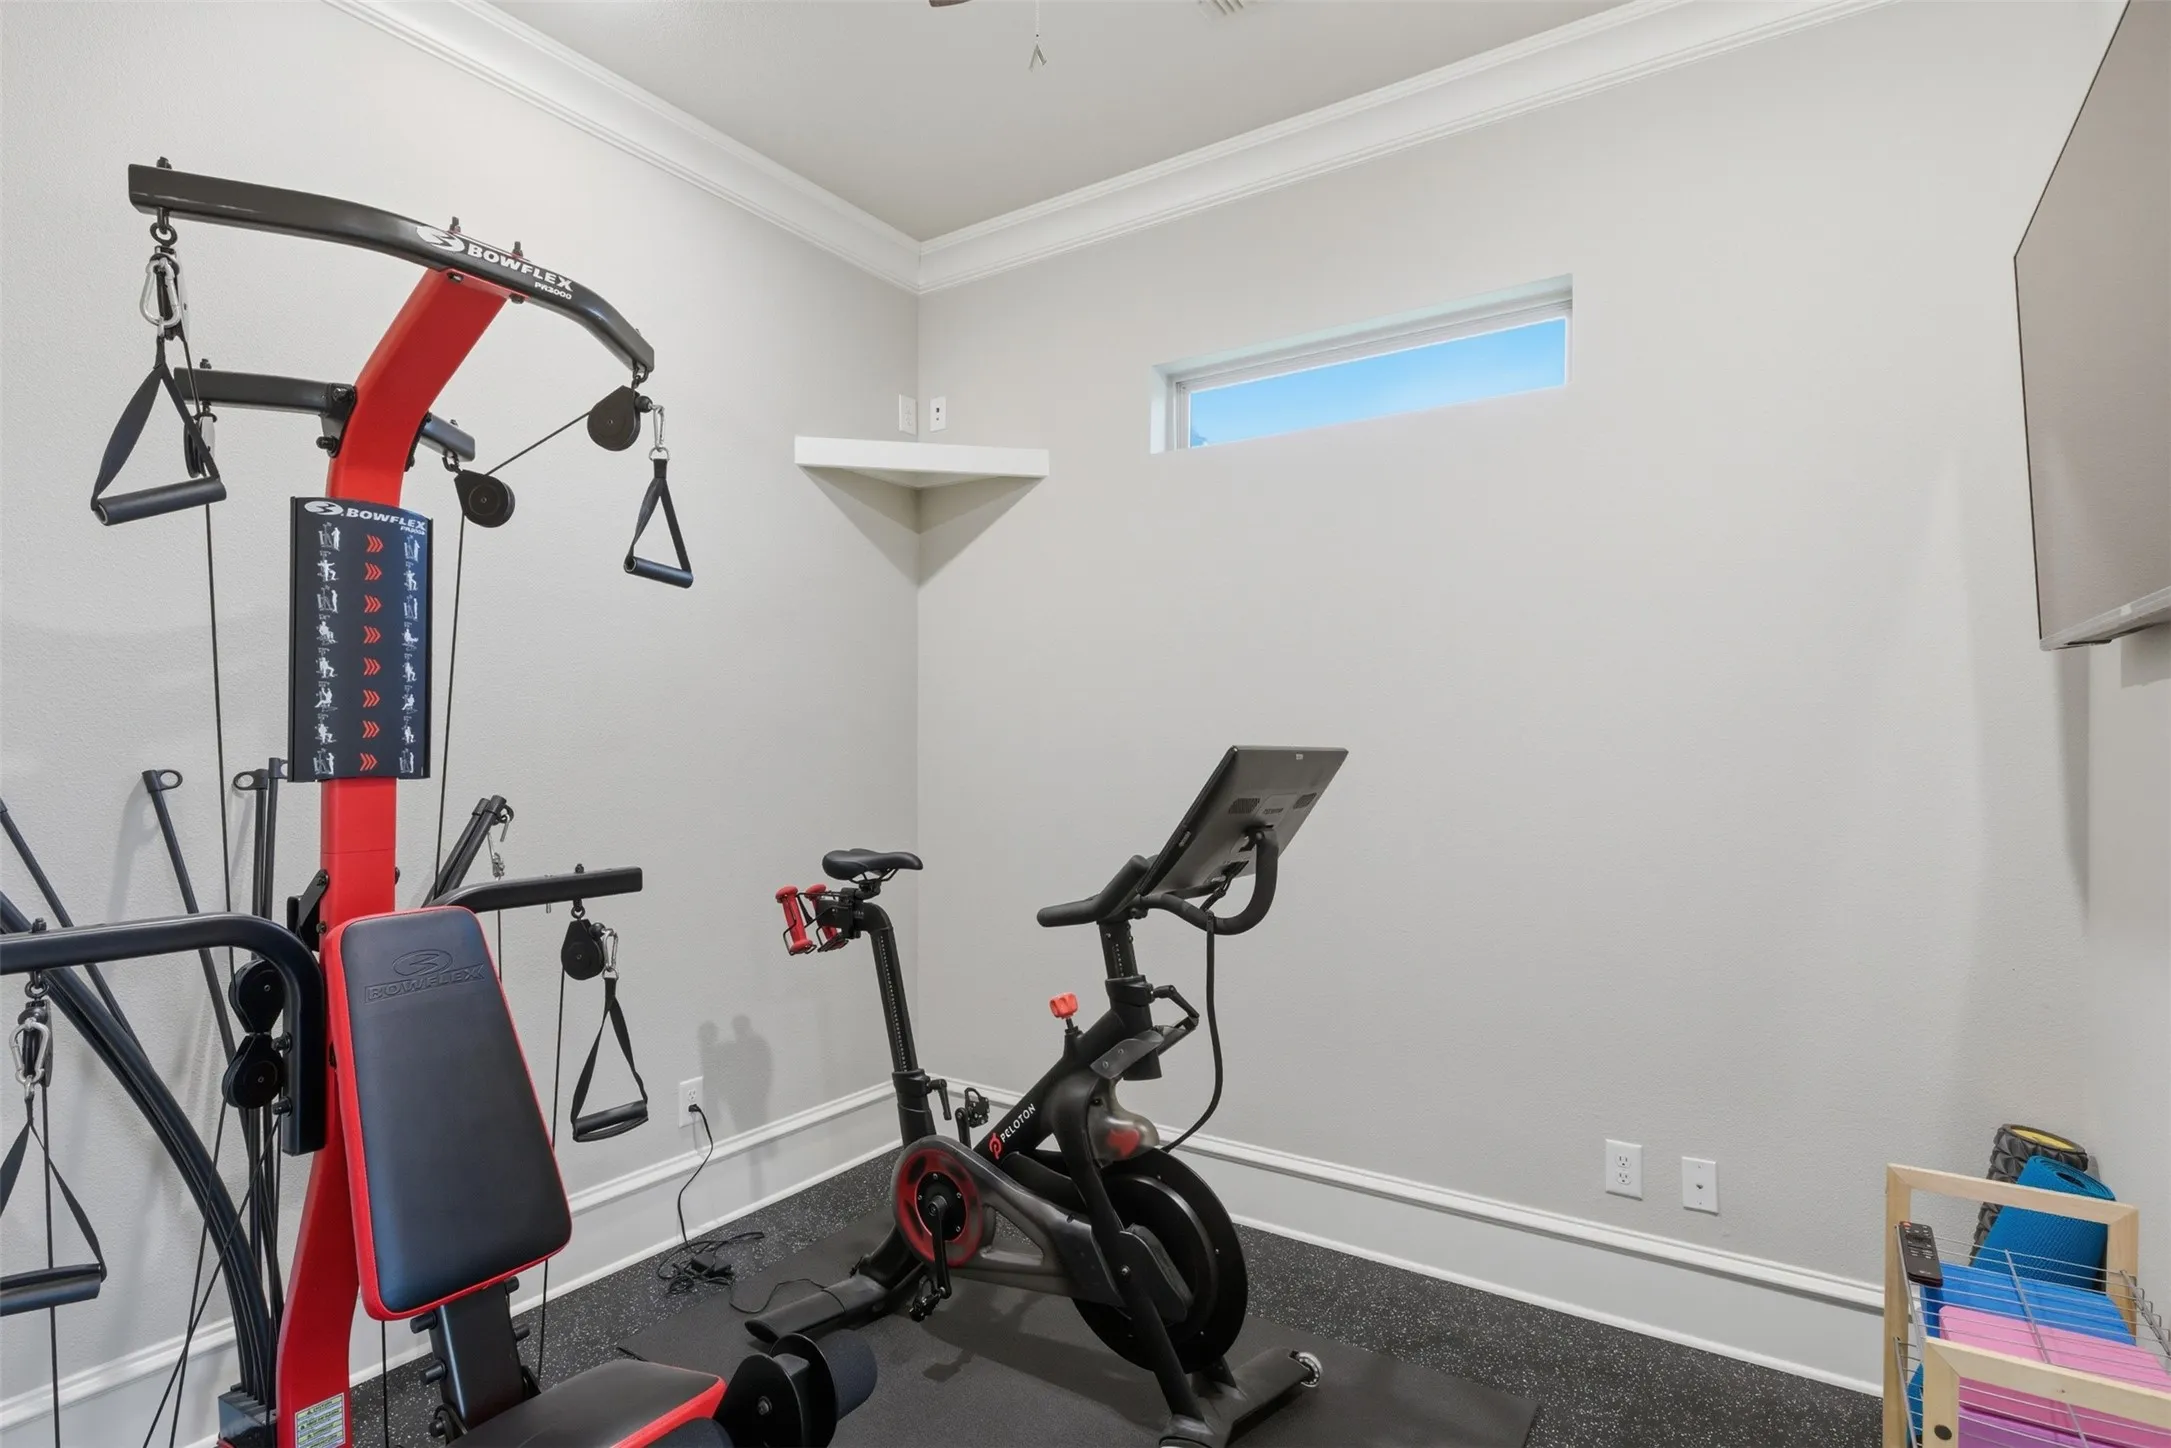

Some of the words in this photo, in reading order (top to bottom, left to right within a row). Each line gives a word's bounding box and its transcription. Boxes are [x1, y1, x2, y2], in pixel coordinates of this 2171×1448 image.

[466, 242, 574, 293] BOWFLEX
[534, 281, 572, 300] PR3000
[346, 507, 427, 531] BOWFLEX
[367, 963, 485, 1001] BOWFLEX
[1000, 1103, 1036, 1143] PELOTON
